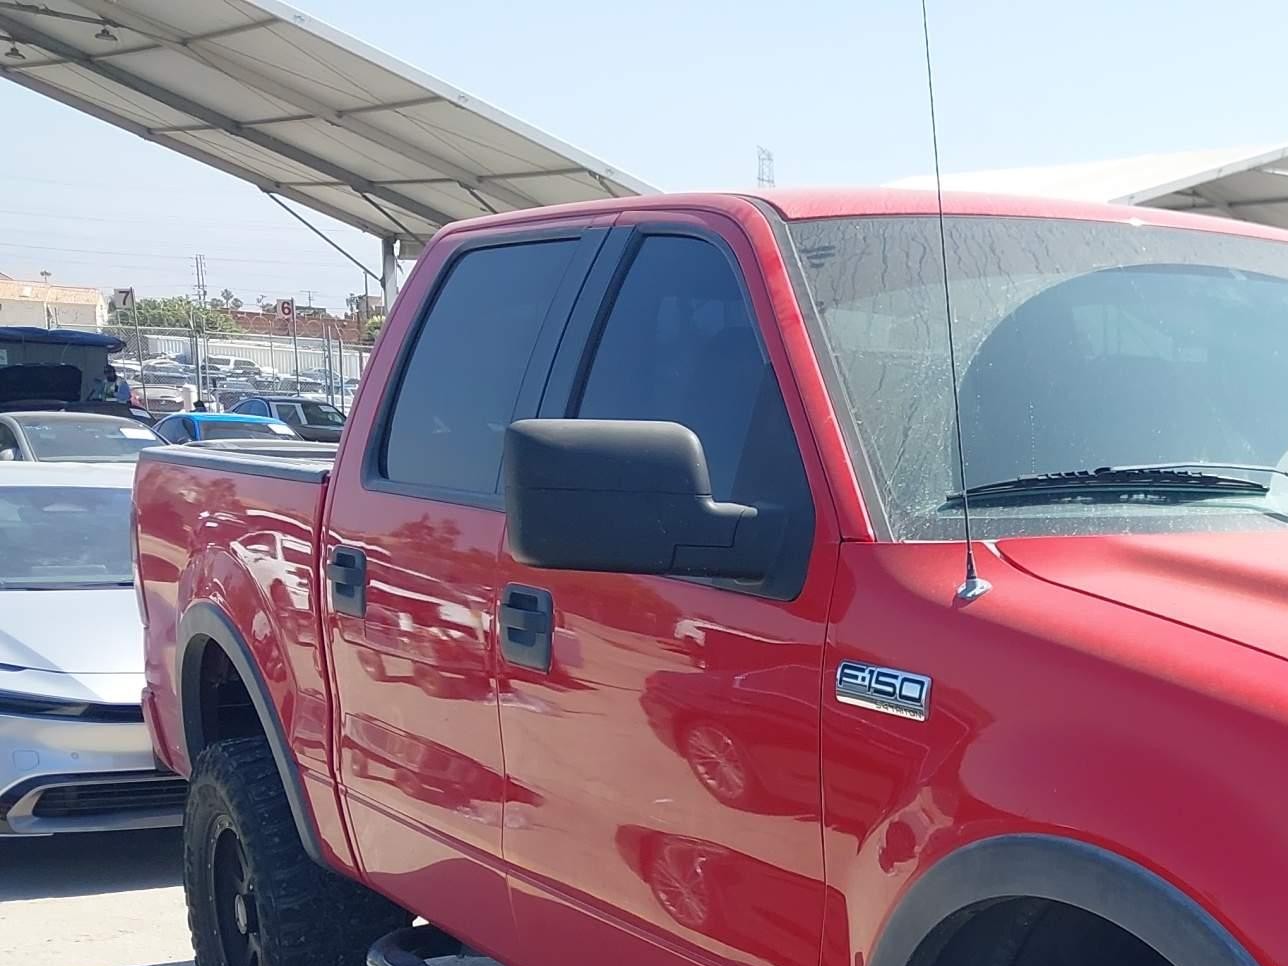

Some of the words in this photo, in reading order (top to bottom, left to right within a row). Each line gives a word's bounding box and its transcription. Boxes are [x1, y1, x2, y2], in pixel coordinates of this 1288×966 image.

[118, 290, 130, 306] 7
[281, 301, 291, 316] 6
[838, 662, 926, 703] F-150
